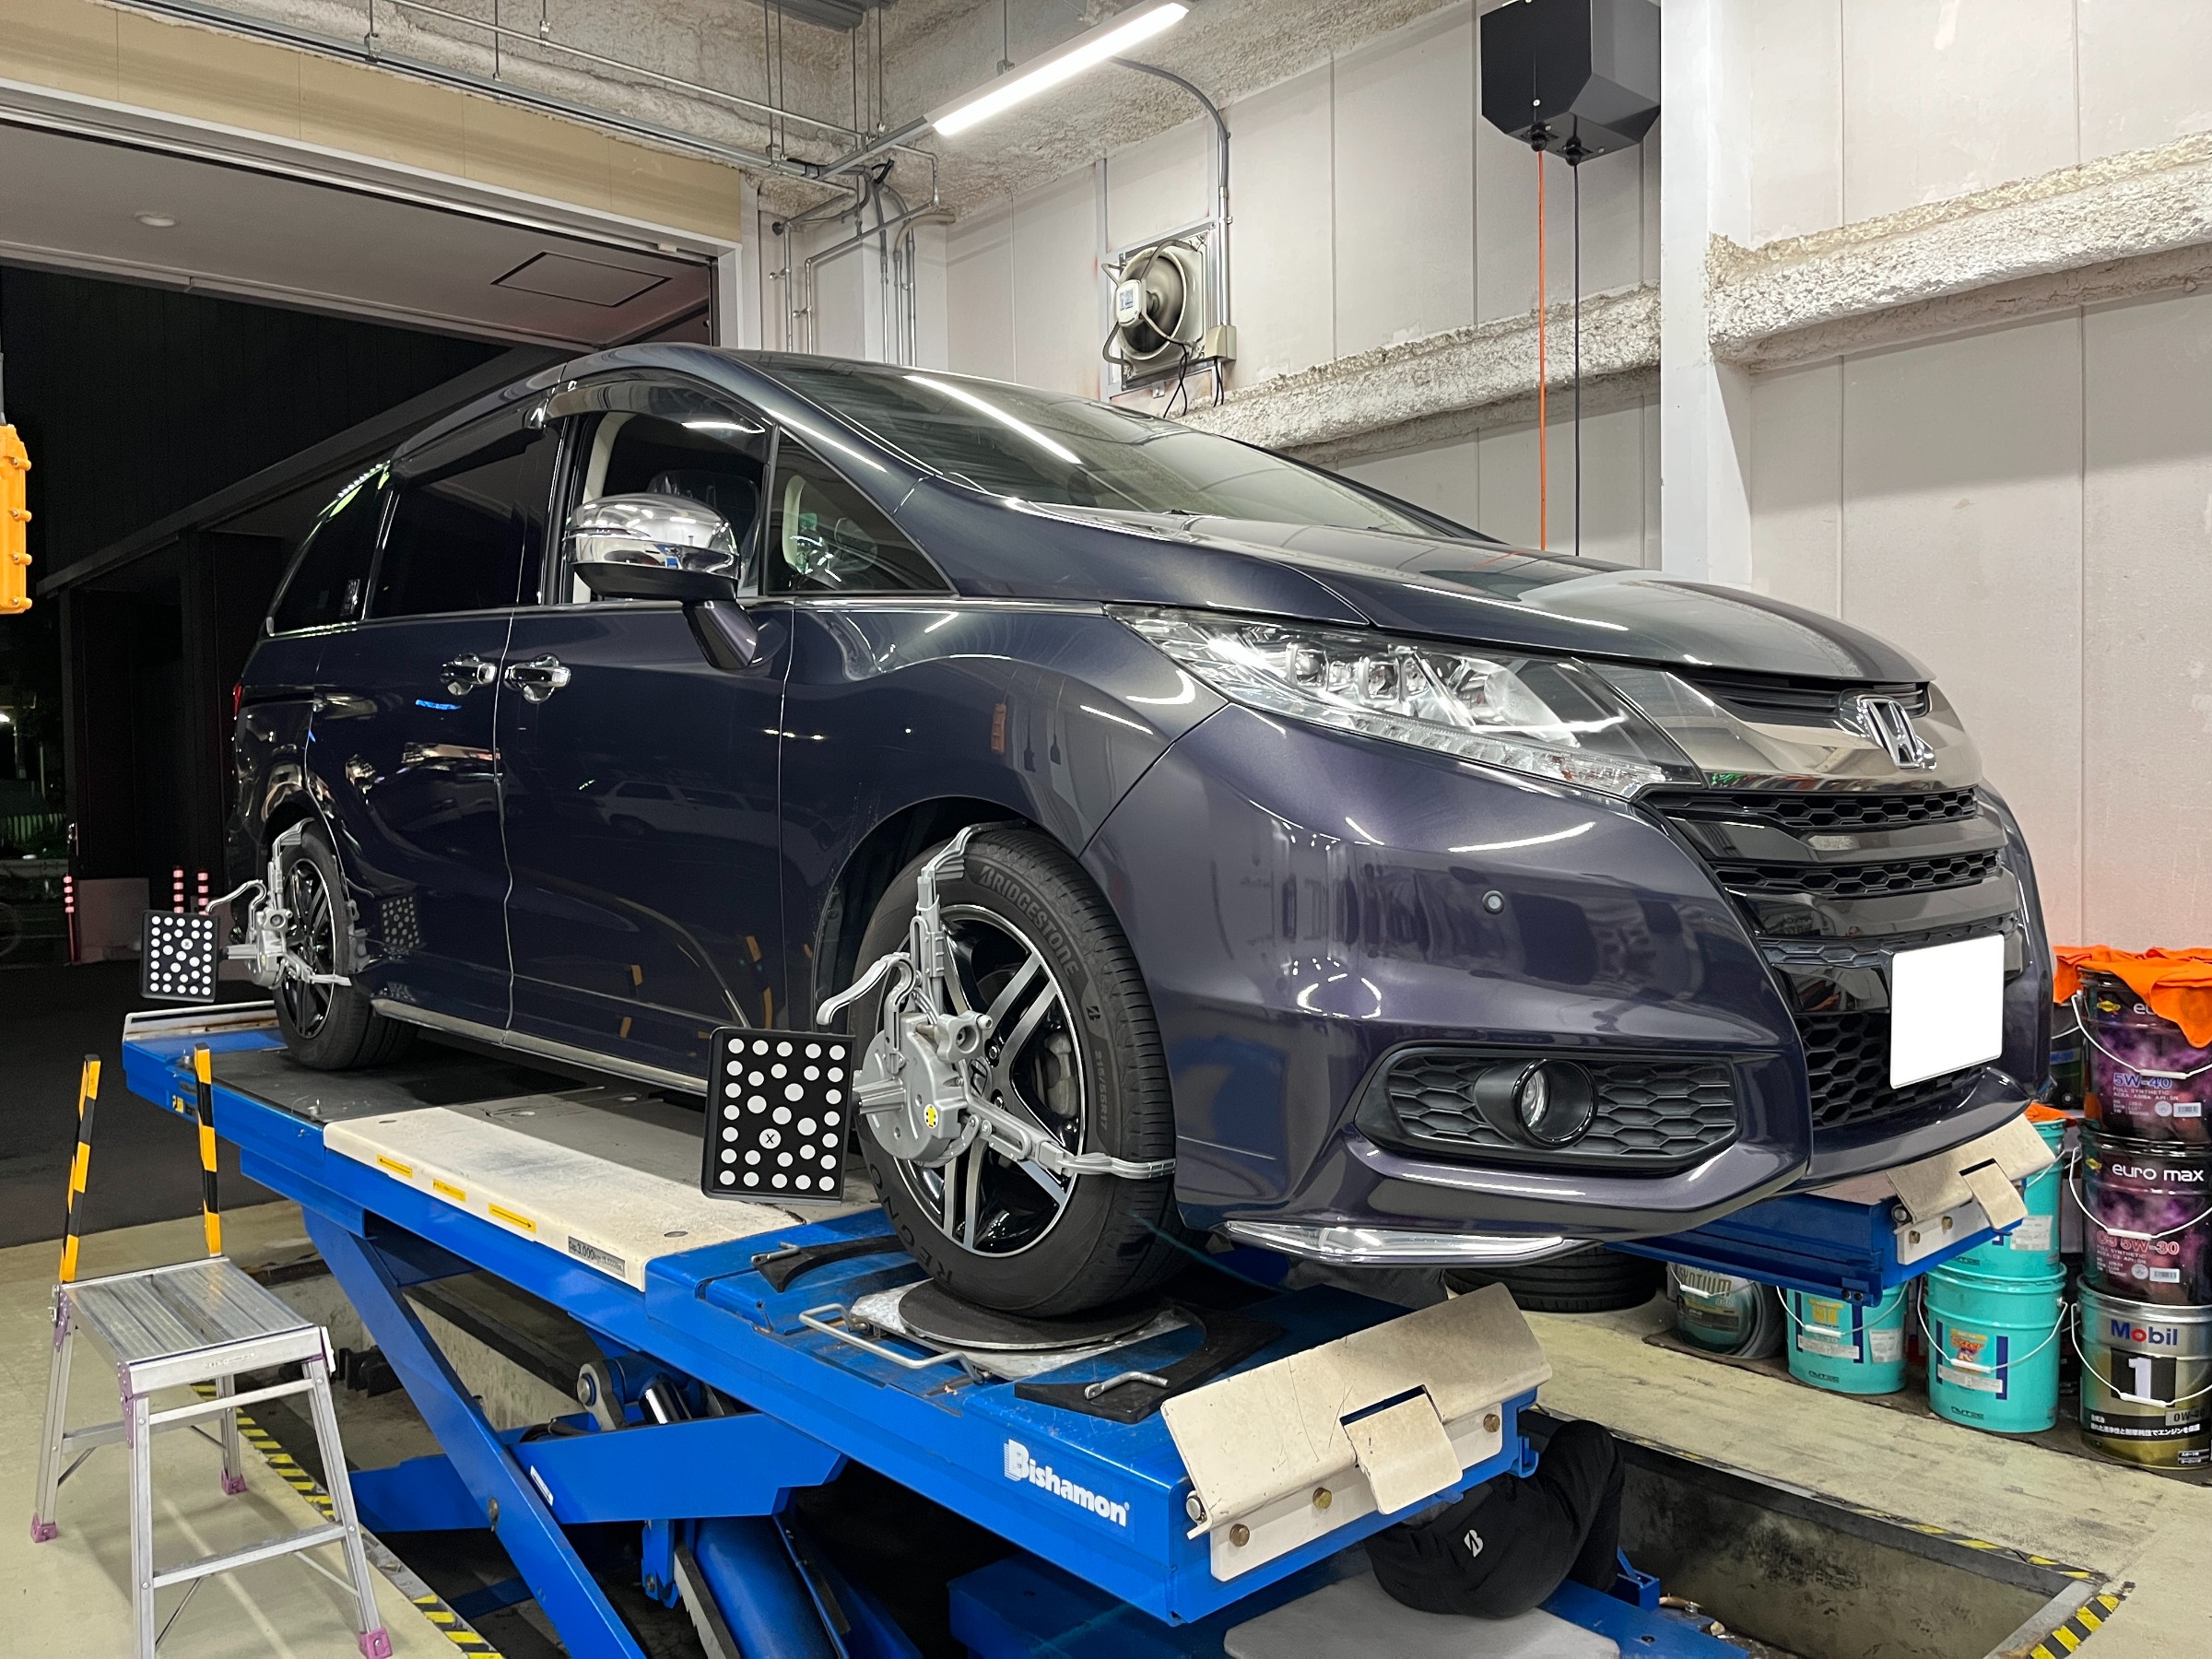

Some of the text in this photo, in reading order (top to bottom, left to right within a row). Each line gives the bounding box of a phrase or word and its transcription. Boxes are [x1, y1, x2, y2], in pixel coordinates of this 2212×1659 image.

[979, 865, 1080, 977] BRIDGESTONE
[2112, 1163, 2205, 1182] euro max
[2111, 1319, 2178, 1346] Mobil
[2128, 1357, 2152, 1400] 1
